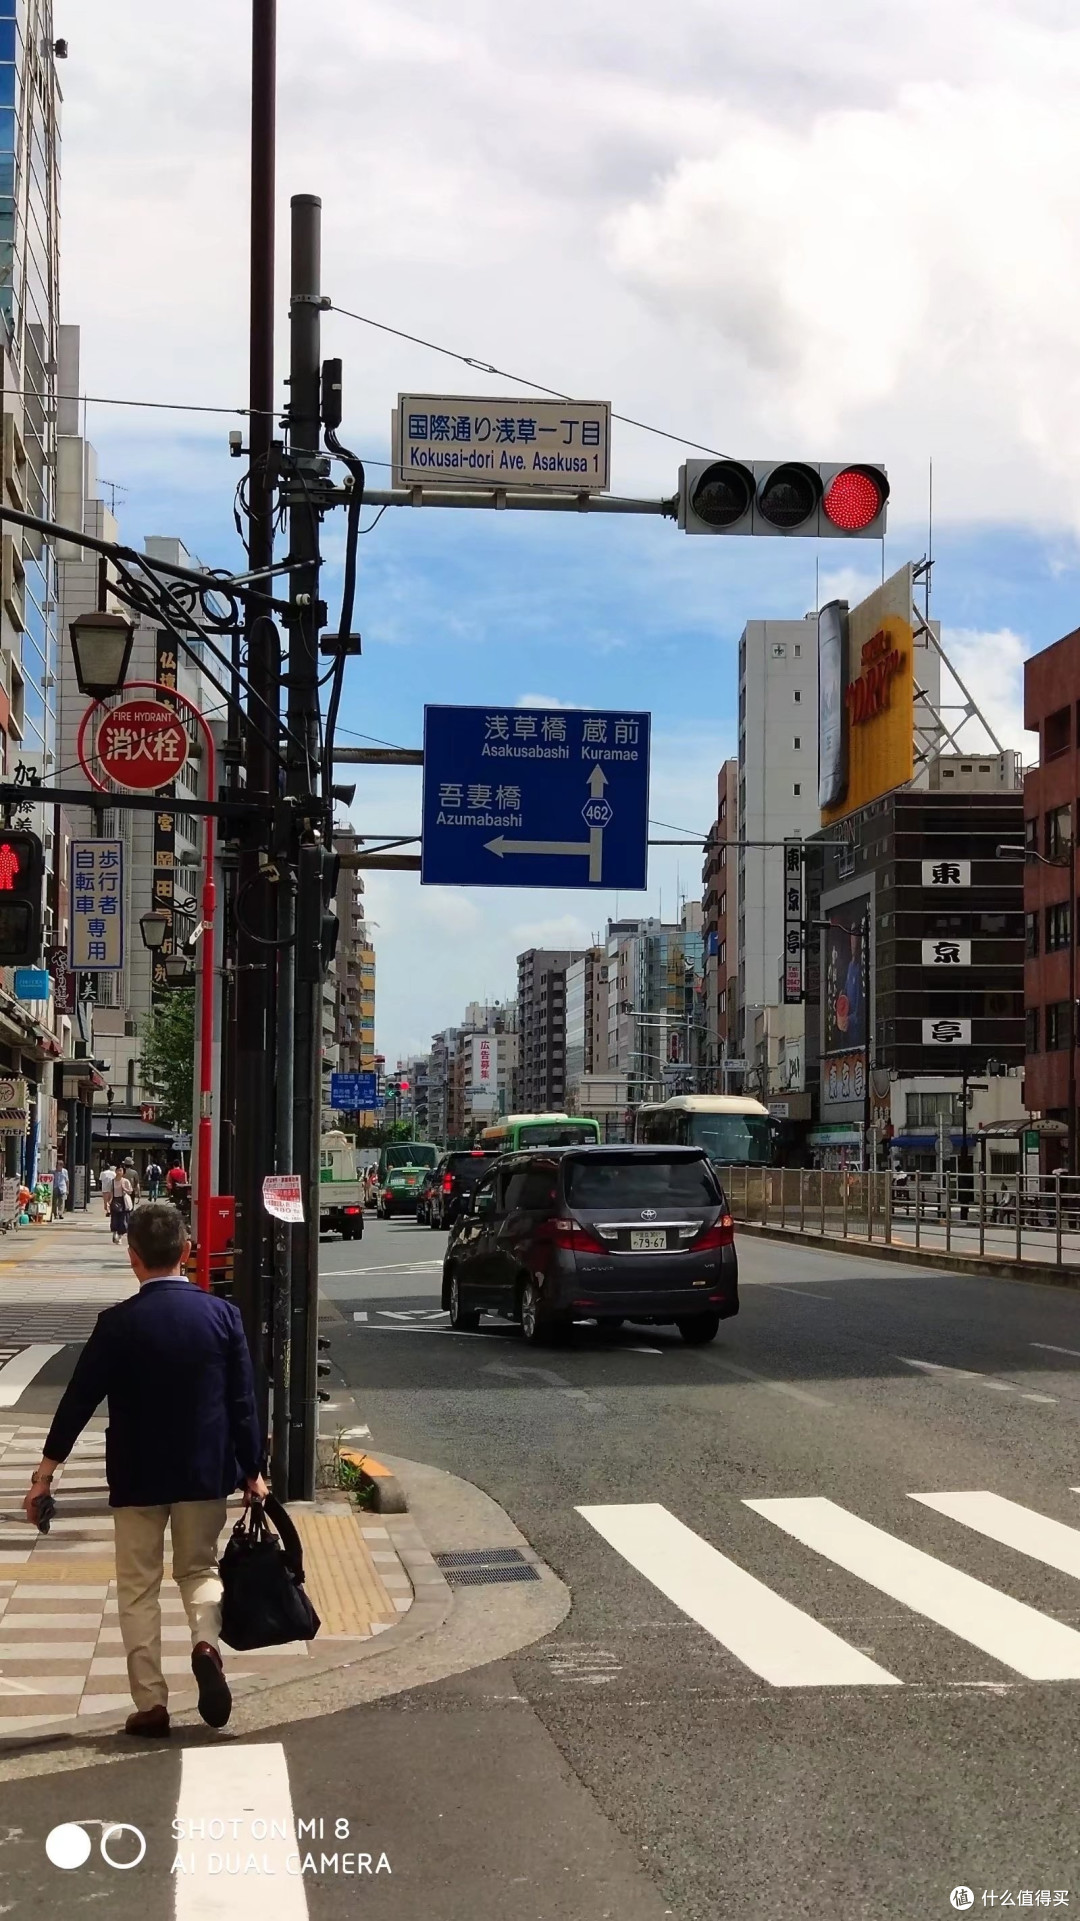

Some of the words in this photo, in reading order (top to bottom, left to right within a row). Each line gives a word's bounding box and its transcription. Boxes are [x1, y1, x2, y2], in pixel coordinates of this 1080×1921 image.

[410, 446, 494, 469] Kokusai-dori
[500, 450, 526, 470] Ave.
[533, 451, 588, 473] Asakusa
[593, 453, 599, 473] 1
[113, 711, 132, 721] FIRE
[134, 712, 173, 722] HYDRANT
[484, 715, 567, 742] 浅草橋
[581, 718, 640, 744] 蔵前
[106, 727, 181, 762] 消火栓
[481, 743, 570, 759] Asakusabashi
[581, 746, 639, 761] Kuramae
[438, 783, 522, 810] 吾妻橋
[436, 811, 523, 827] Azumabashi
[585, 805, 608, 820] 462
[75, 849, 95, 915] 自転車
[98, 849, 118, 915] 歩行者
[87, 918, 107, 961] 専用
[480, 1040, 490, 1079] 広告募集
